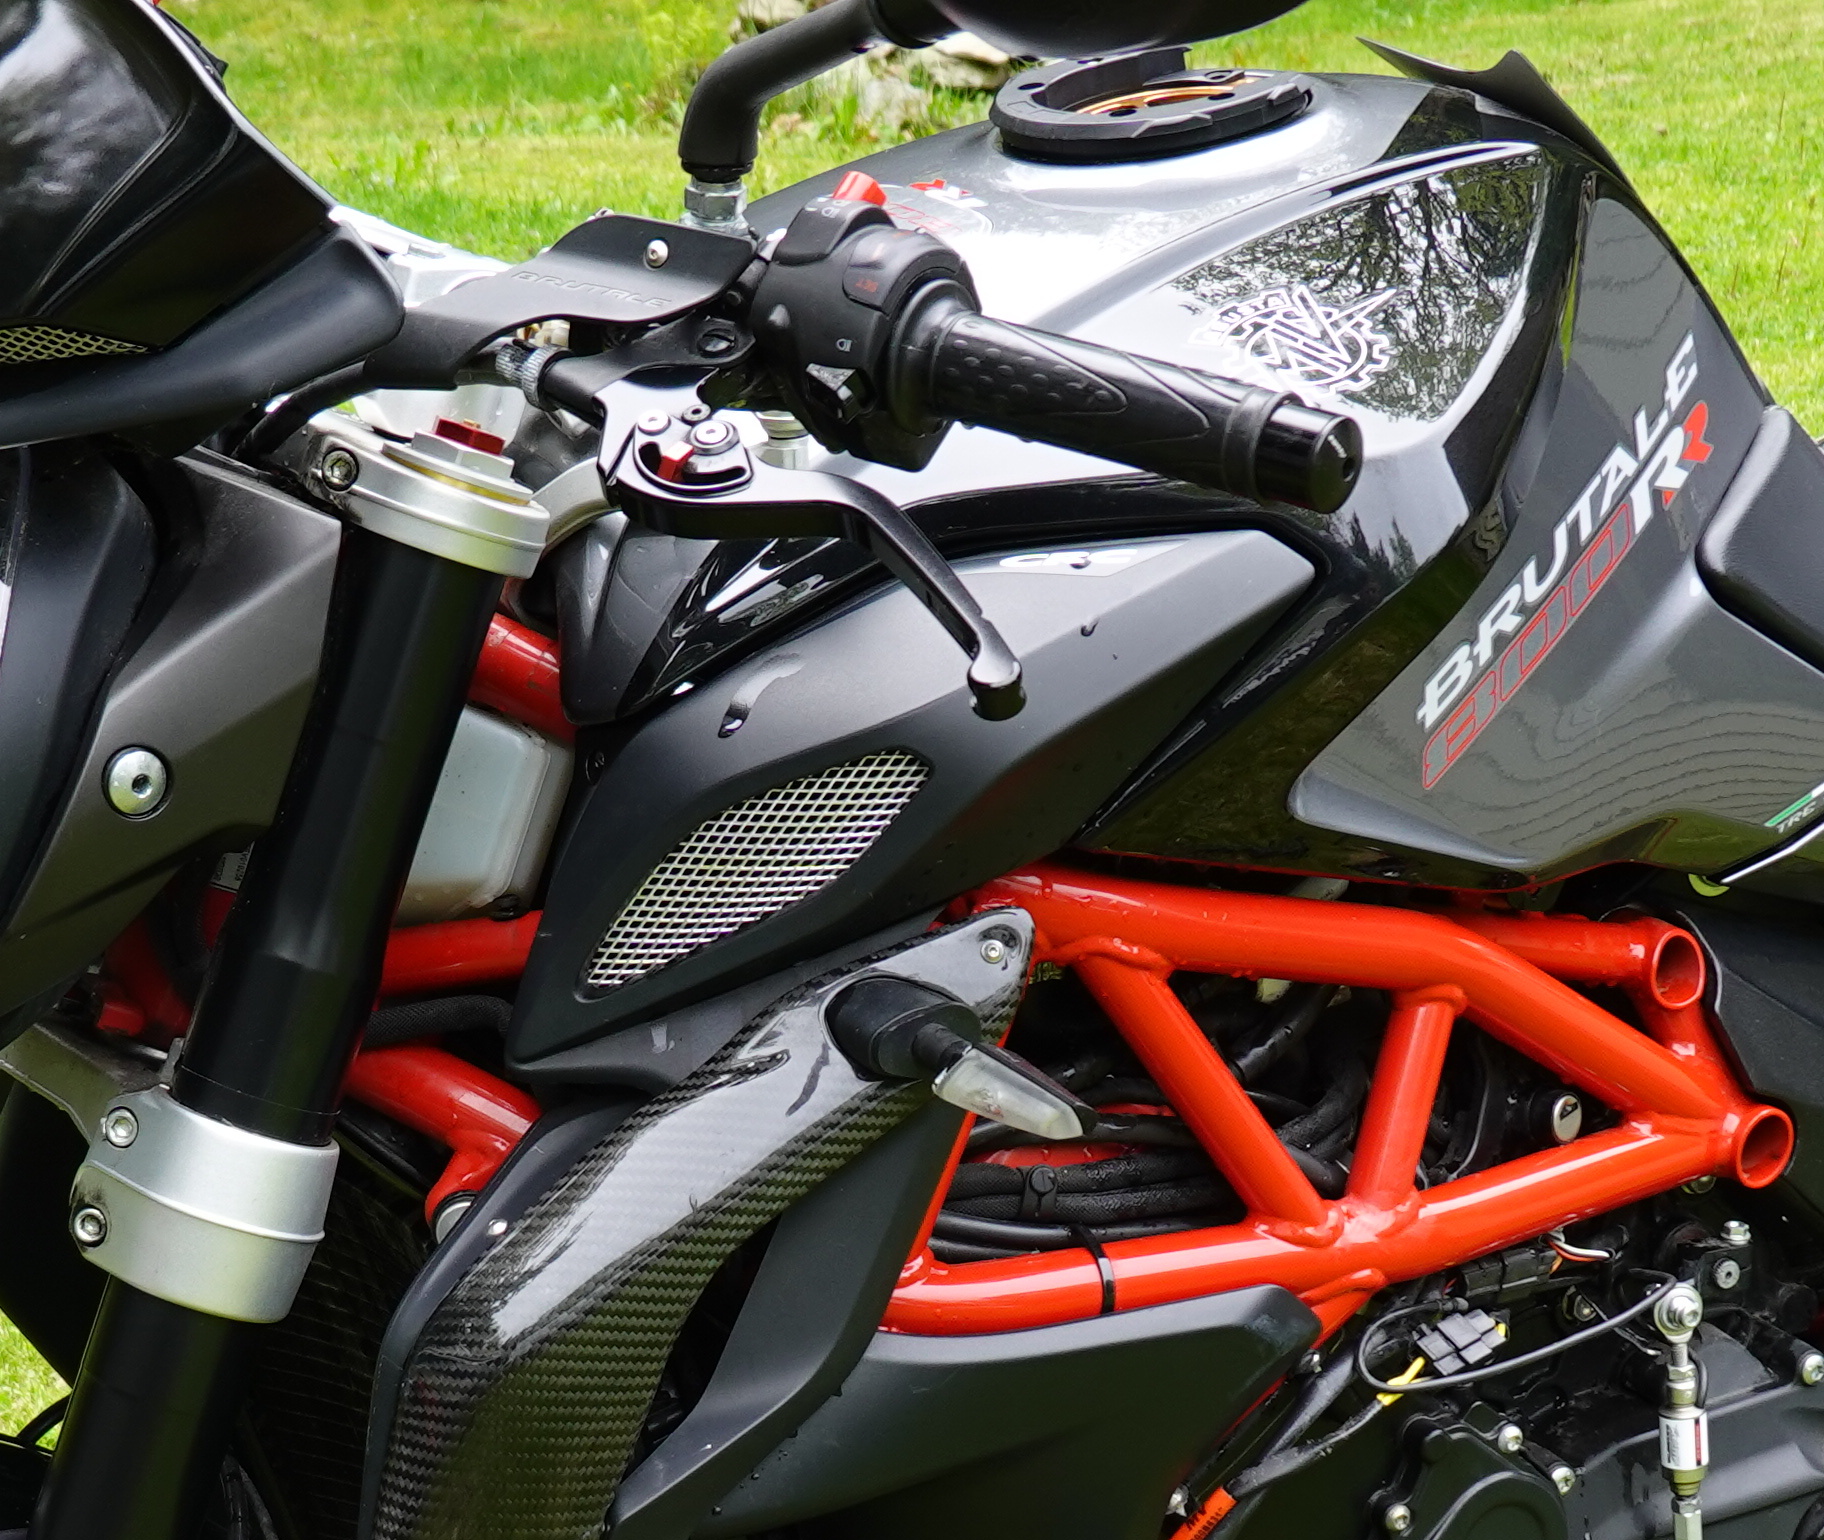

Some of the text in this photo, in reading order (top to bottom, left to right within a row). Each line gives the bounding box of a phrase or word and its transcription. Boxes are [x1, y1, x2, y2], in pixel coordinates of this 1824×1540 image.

[510, 270, 672, 308] BRUTALE
[1415, 328, 1700, 735] BRUTALE
[1776, 800, 1817, 834] TRE
